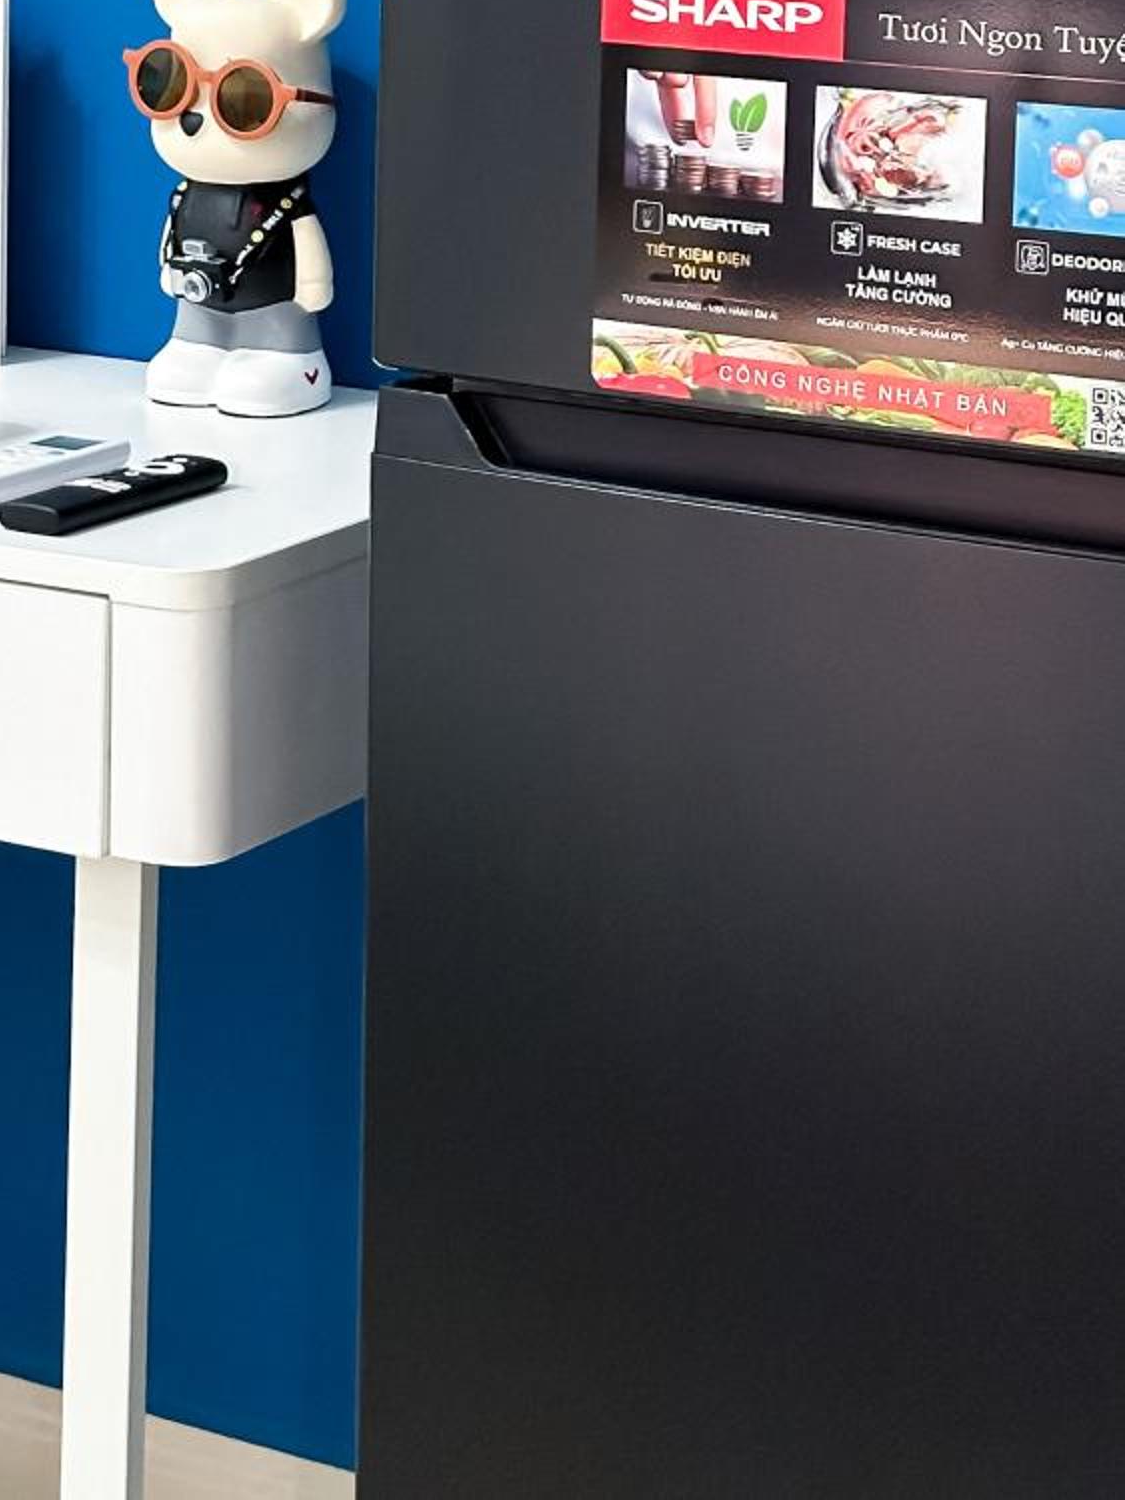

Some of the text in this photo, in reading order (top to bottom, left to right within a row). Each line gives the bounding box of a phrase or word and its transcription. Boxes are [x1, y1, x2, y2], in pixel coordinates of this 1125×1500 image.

[878, 12, 948, 45] Tươi
[958, 19, 1044, 57] Ngon
[666, 213, 771, 237] INVERTER
[867, 235, 962, 258] FRESH CASE
[894, 271, 937, 289] LẠNH
[719, 364, 787, 389] CÔNG
[798, 374, 866, 402] NGHỆ
